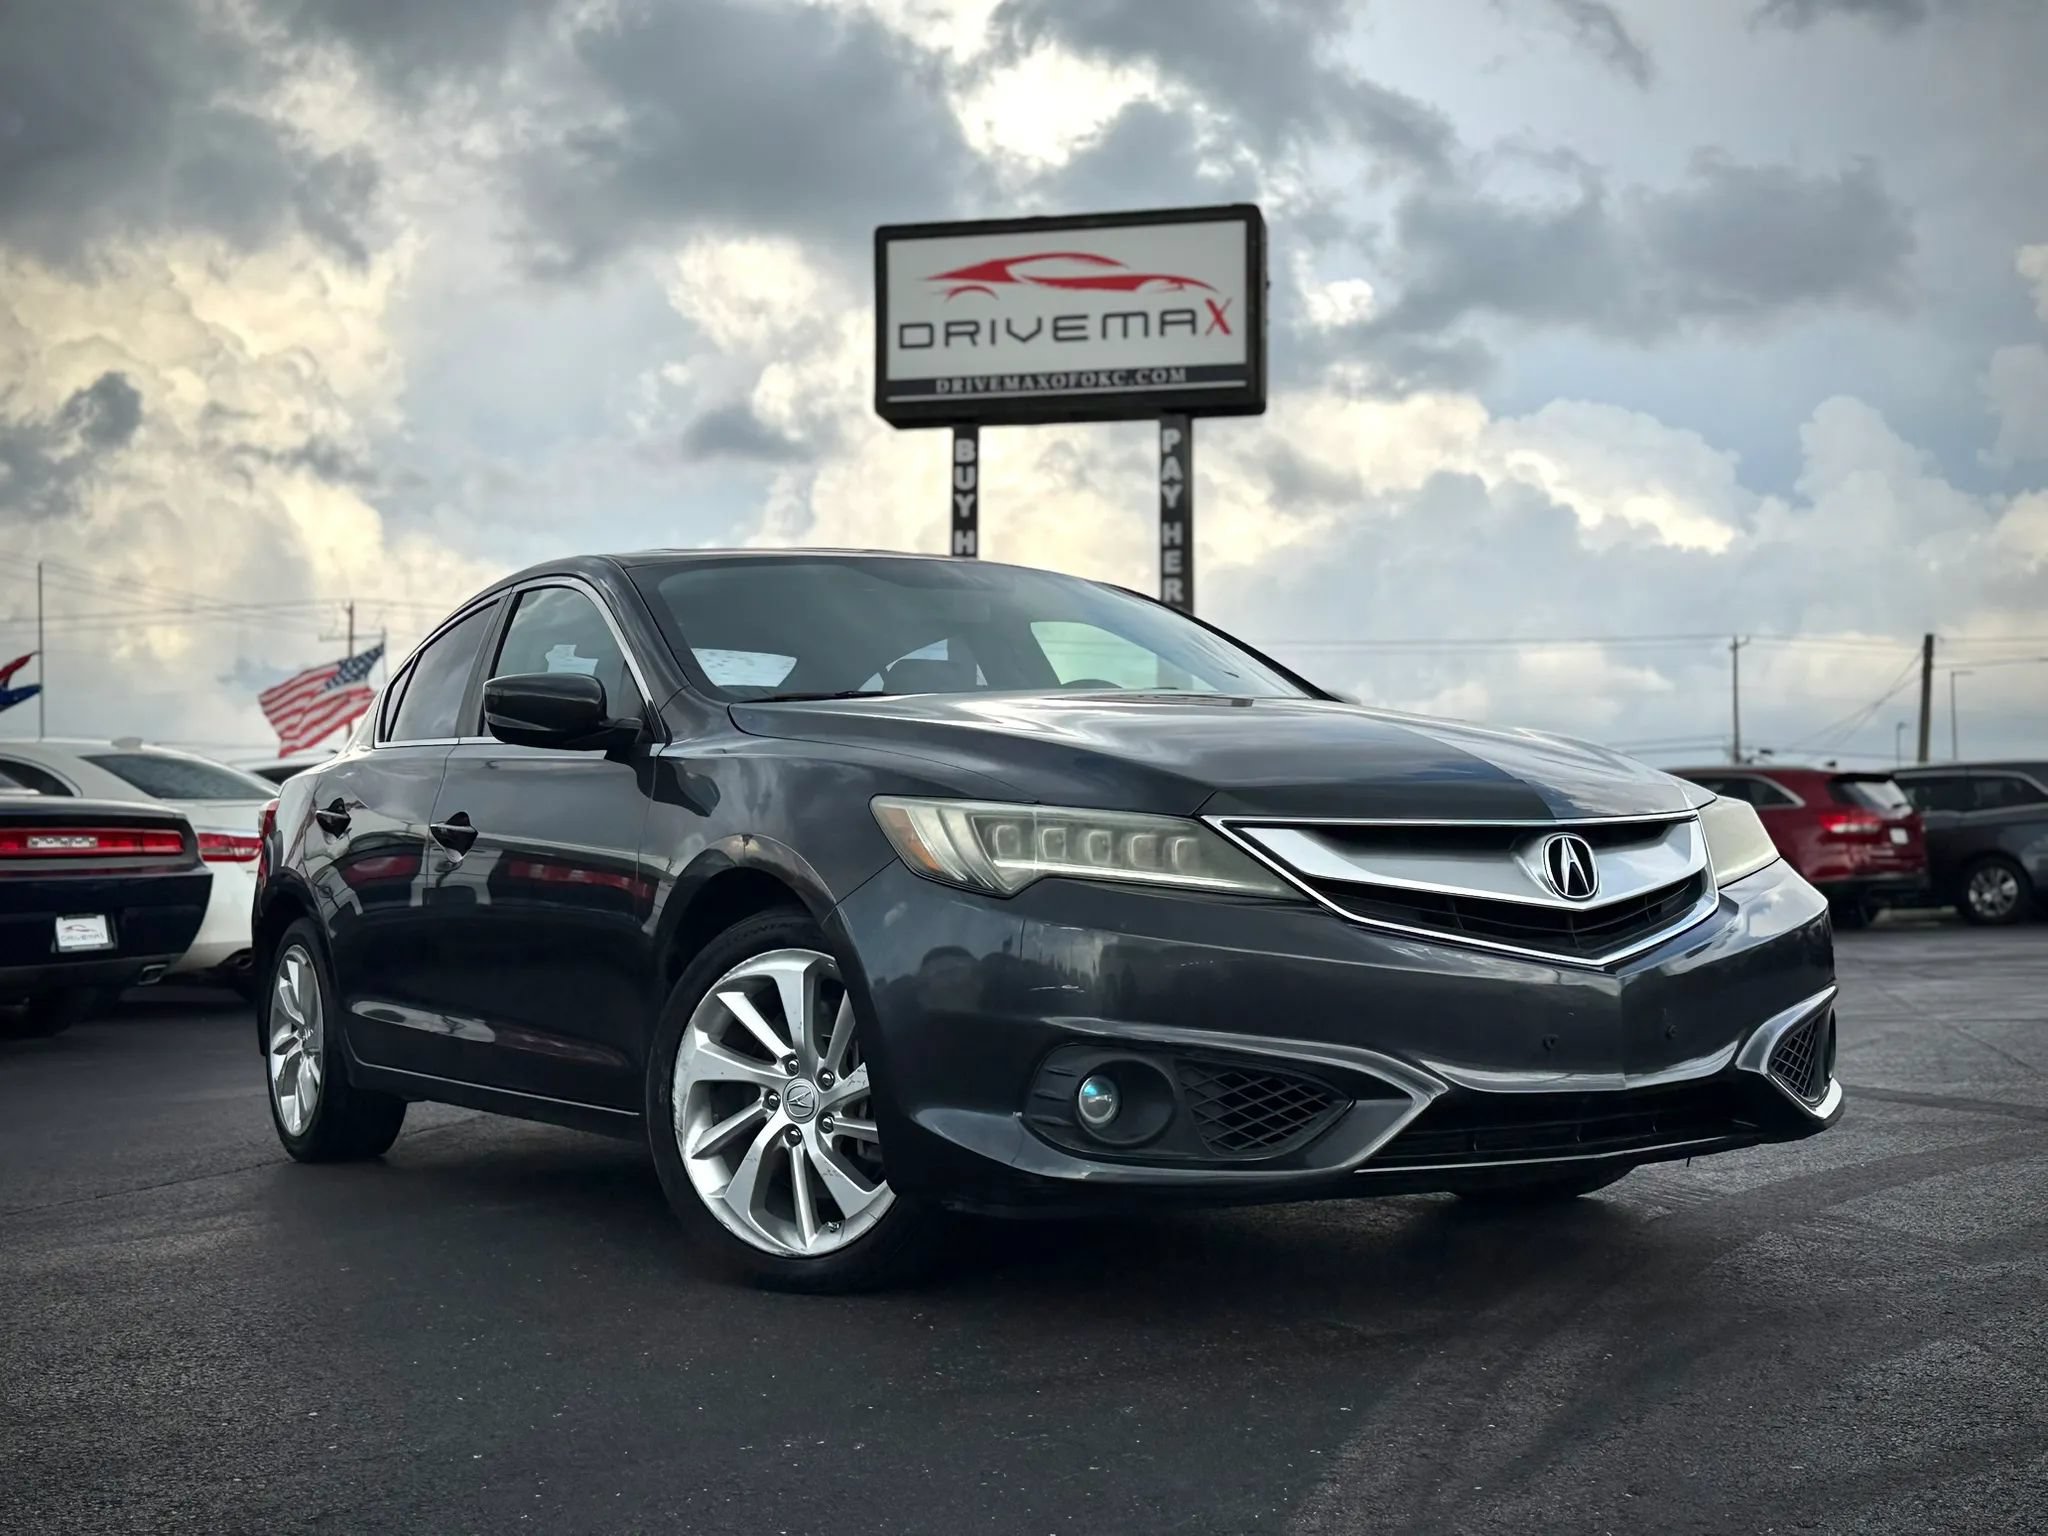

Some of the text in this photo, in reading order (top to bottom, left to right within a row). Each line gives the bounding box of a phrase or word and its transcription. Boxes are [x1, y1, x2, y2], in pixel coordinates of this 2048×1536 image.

[899, 298, 1232, 350] DRIVEMAX
[935, 367, 1187, 394] DRIVEMAXOFOKC.COM
[954, 438, 976, 518] BUY
[1161, 428, 1184, 609] PAY HER
